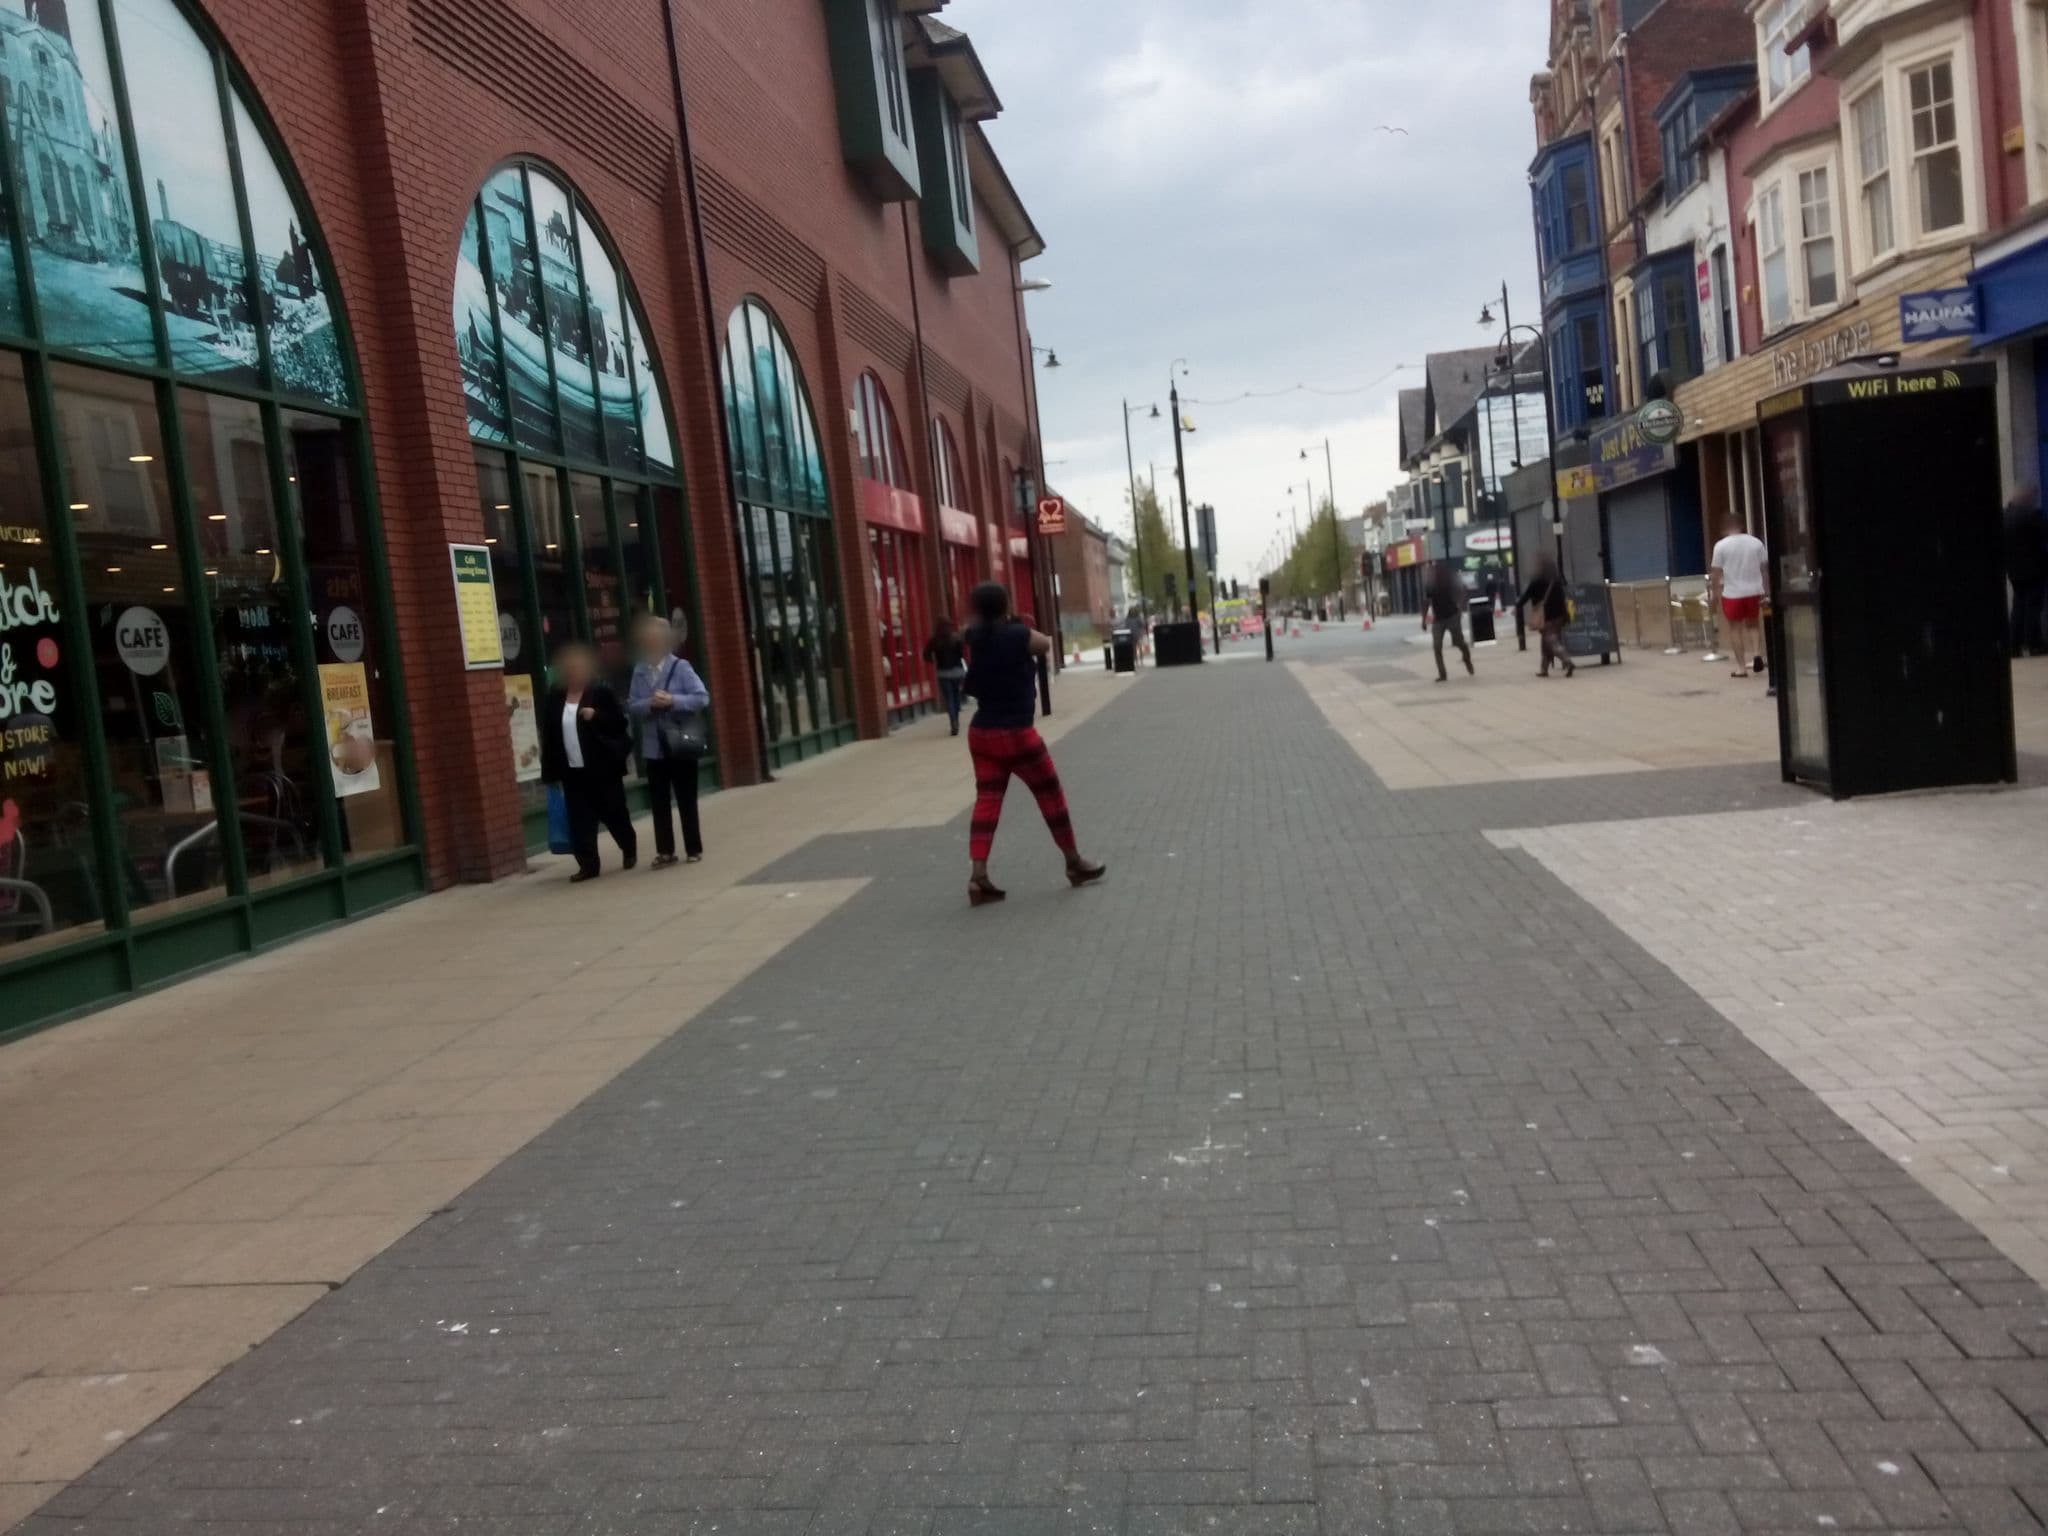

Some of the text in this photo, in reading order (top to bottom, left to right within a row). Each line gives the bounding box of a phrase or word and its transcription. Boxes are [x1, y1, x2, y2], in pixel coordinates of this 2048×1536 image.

[1904, 303, 1975, 325] HALIFAX
[1848, 375, 1938, 399] WiFi here
[4, 755, 47, 780] NOW!
